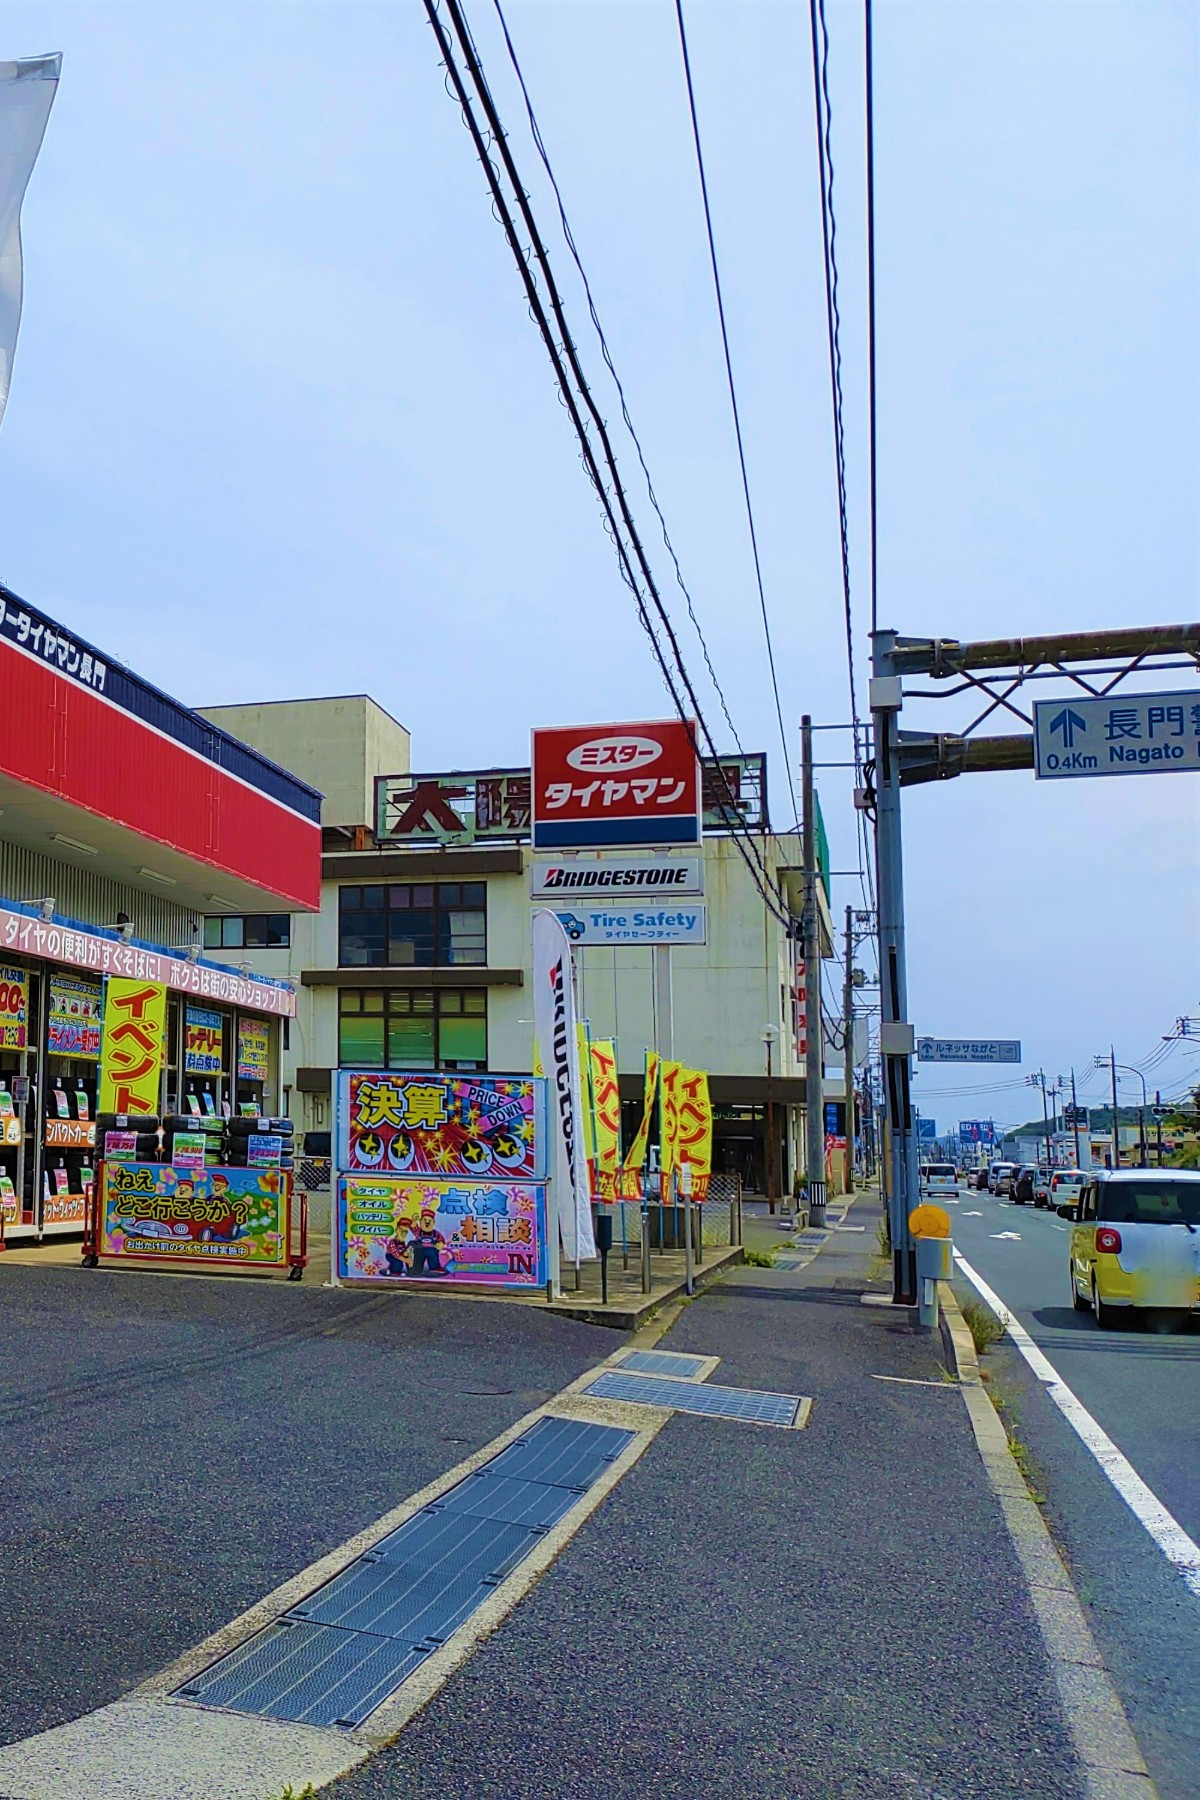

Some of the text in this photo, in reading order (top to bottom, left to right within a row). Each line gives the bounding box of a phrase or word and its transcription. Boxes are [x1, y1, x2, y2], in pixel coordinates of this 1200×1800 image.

[580, 744, 654, 765] ミスター
[1047, 743, 1184, 770] 0.4Km Nagato
[544, 778, 686, 809] タイヤマン
[543, 868, 688, 888] BRIDGESTONE
[590, 912, 697, 930] Tire Safety
[605, 930, 679, 938] タイヤセーフティー
[108, 985, 161, 1114] イベント
[936, 1043, 997, 1053] ルネッサながと
[357, 1082, 447, 1130] 決算
[468, 1087, 505, 1108] PRICE
[487, 1101, 524, 1127] DOWN
[115, 1168, 156, 1192] ねえ
[358, 1187, 386, 1195] タイヤ
[115, 1195, 248, 1224] どこ行こうか?
[358, 1200, 387, 1208] オイル
[437, 1188, 510, 1216] 点検
[357, 1213, 390, 1222] バッテリー
[126, 1240, 248, 1257] お出かけ前のタイヤ点検実施中
[507, 1253, 534, 1274] IN
